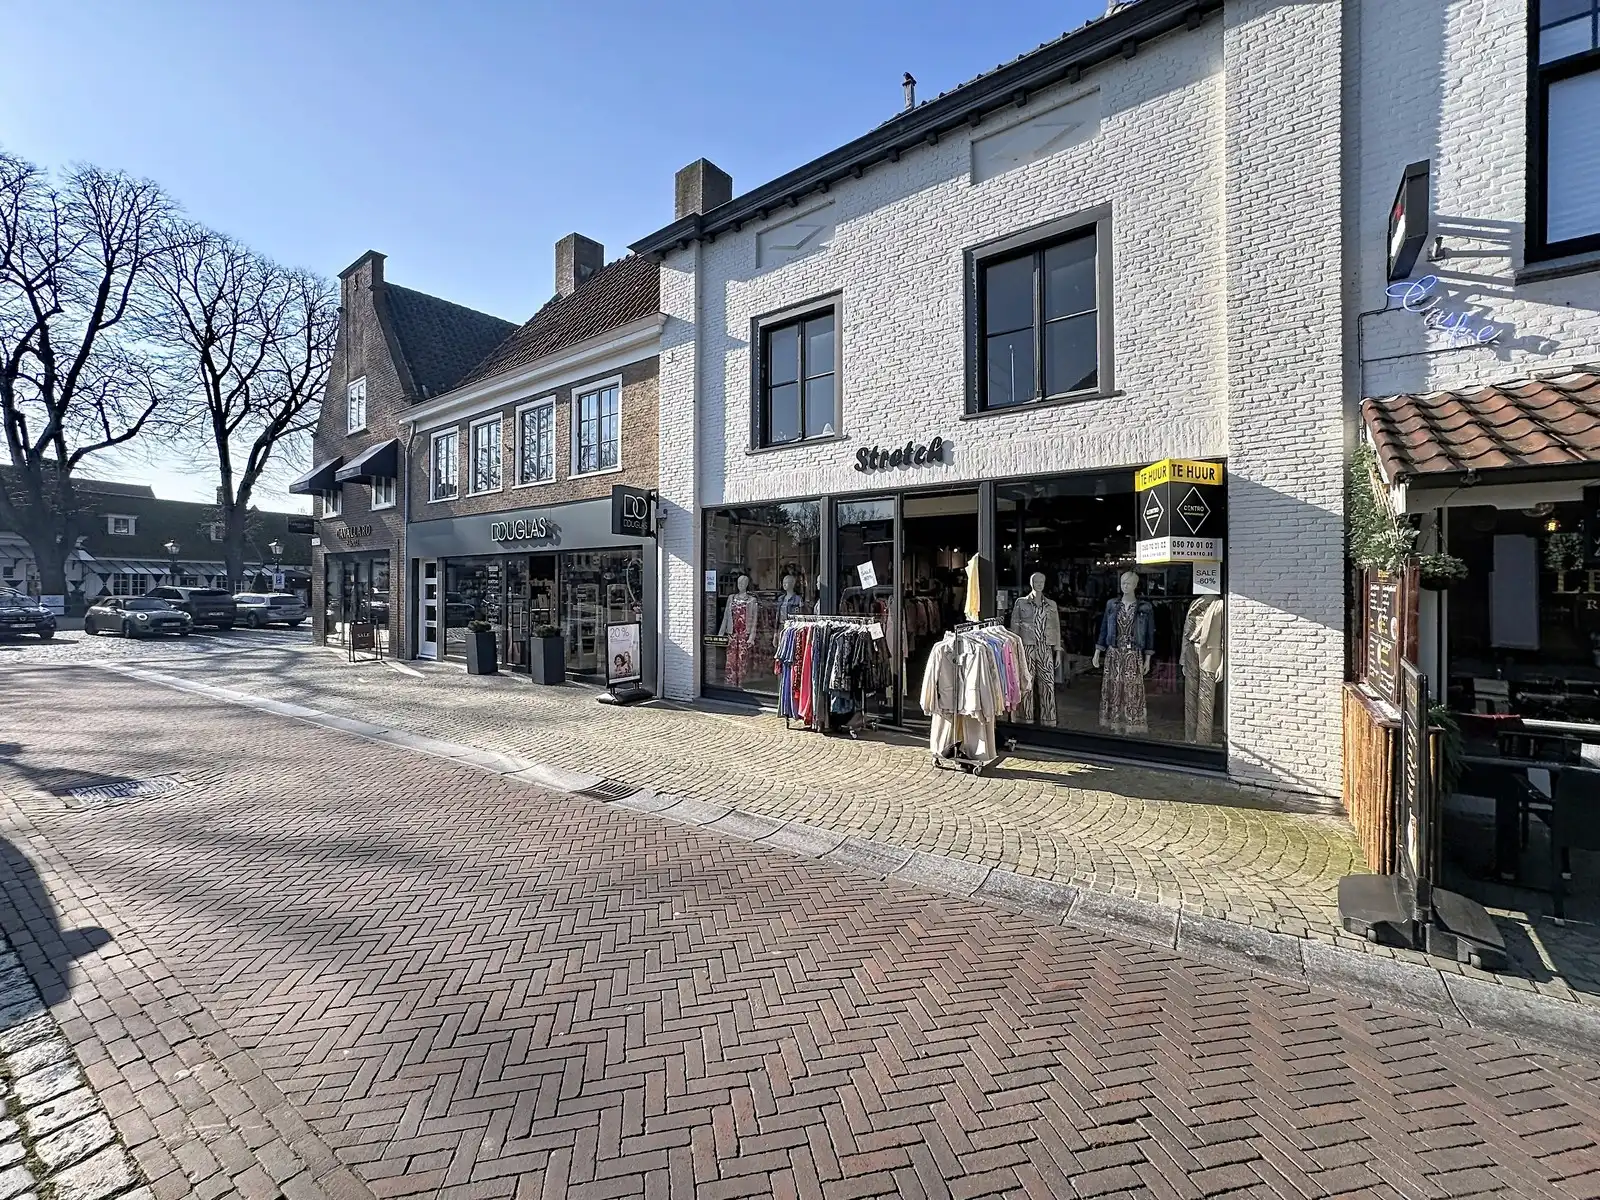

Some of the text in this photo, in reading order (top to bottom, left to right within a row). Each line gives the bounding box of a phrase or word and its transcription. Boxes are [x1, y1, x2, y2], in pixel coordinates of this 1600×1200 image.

[854, 436, 943, 472] Stretch
[1141, 465, 1167, 487] TE HUUR
[1171, 463, 1215, 481] TE HUUR
[1183, 504, 1205, 512] CENTRO
[491, 516, 547, 542] DOUGLAS
[623, 518, 648, 530] DOUGLAS
[1172, 540, 1214, 549] 050 70 01 02
[1196, 569, 1217, 577] SALE
